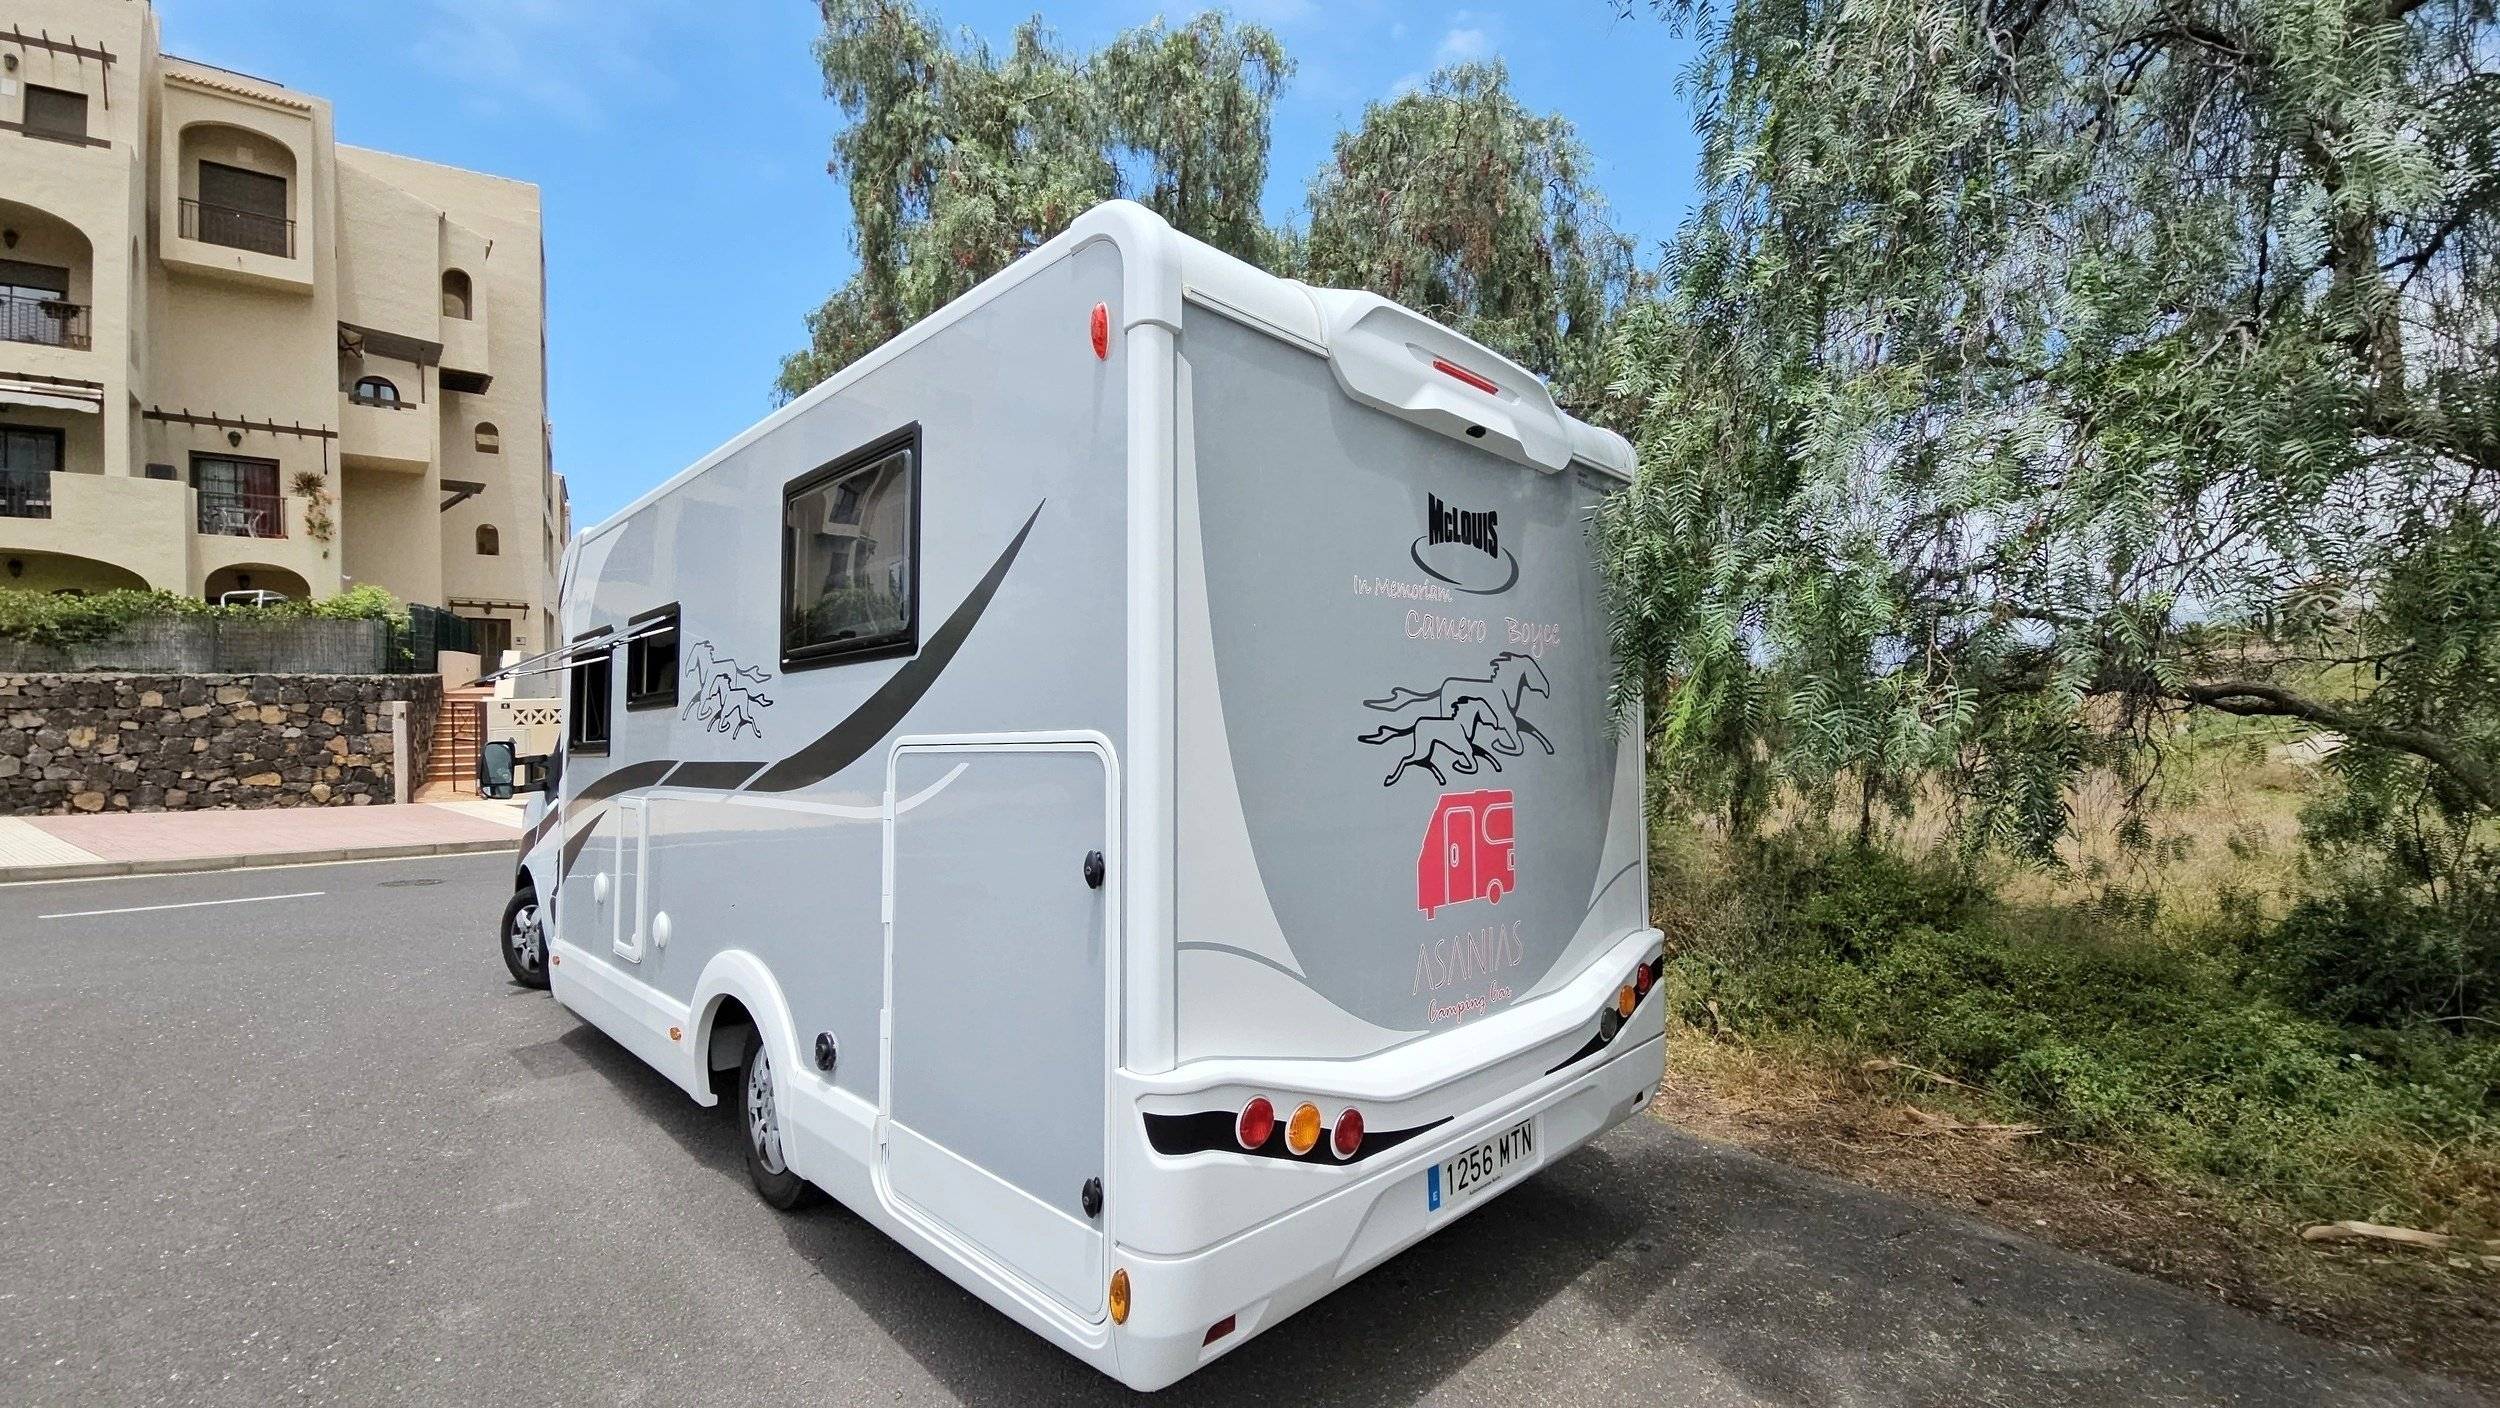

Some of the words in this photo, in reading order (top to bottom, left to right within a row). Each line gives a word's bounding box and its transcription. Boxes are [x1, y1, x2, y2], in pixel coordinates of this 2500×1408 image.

[1504, 616, 1561, 659] Boyce
[1412, 920, 1523, 996] ASANIAS
[1428, 994, 1487, 1024] Camping
[1447, 1145, 1493, 1196] 1256
[1499, 1123, 1532, 1168] MTN
